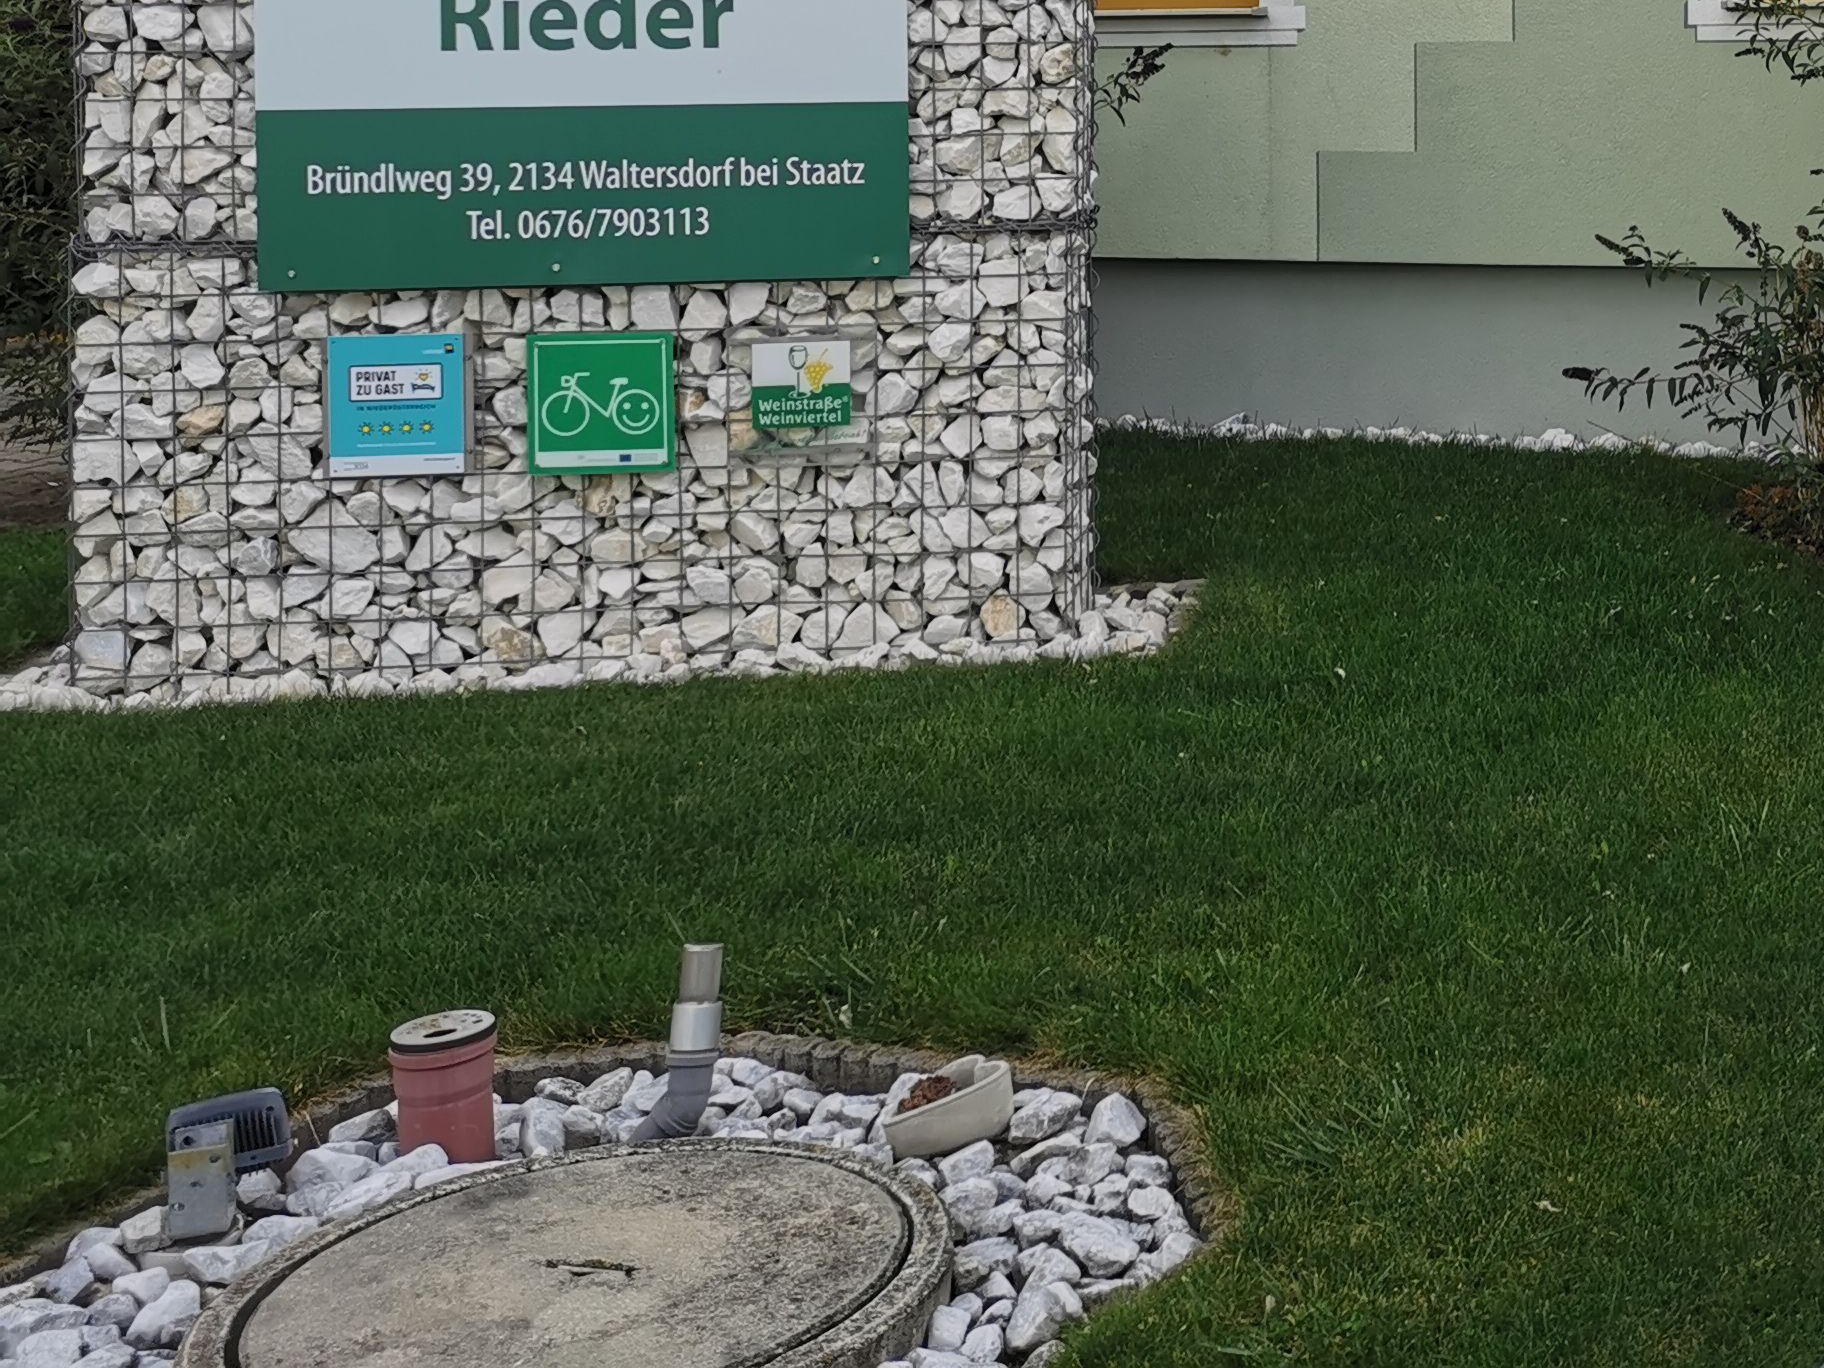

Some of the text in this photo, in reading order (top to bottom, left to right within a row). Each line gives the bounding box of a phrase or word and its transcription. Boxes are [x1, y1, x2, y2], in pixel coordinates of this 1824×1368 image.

[307, 156, 866, 199] Bründlweg 39, 2134 Waltersdorf bei Staatz
[466, 206, 710, 240] Tel. 0676/7903113
[356, 371, 396, 383] PRIVAT
[356, 383, 405, 396] ZU GAST
[758, 410, 842, 425] Weinviertel
